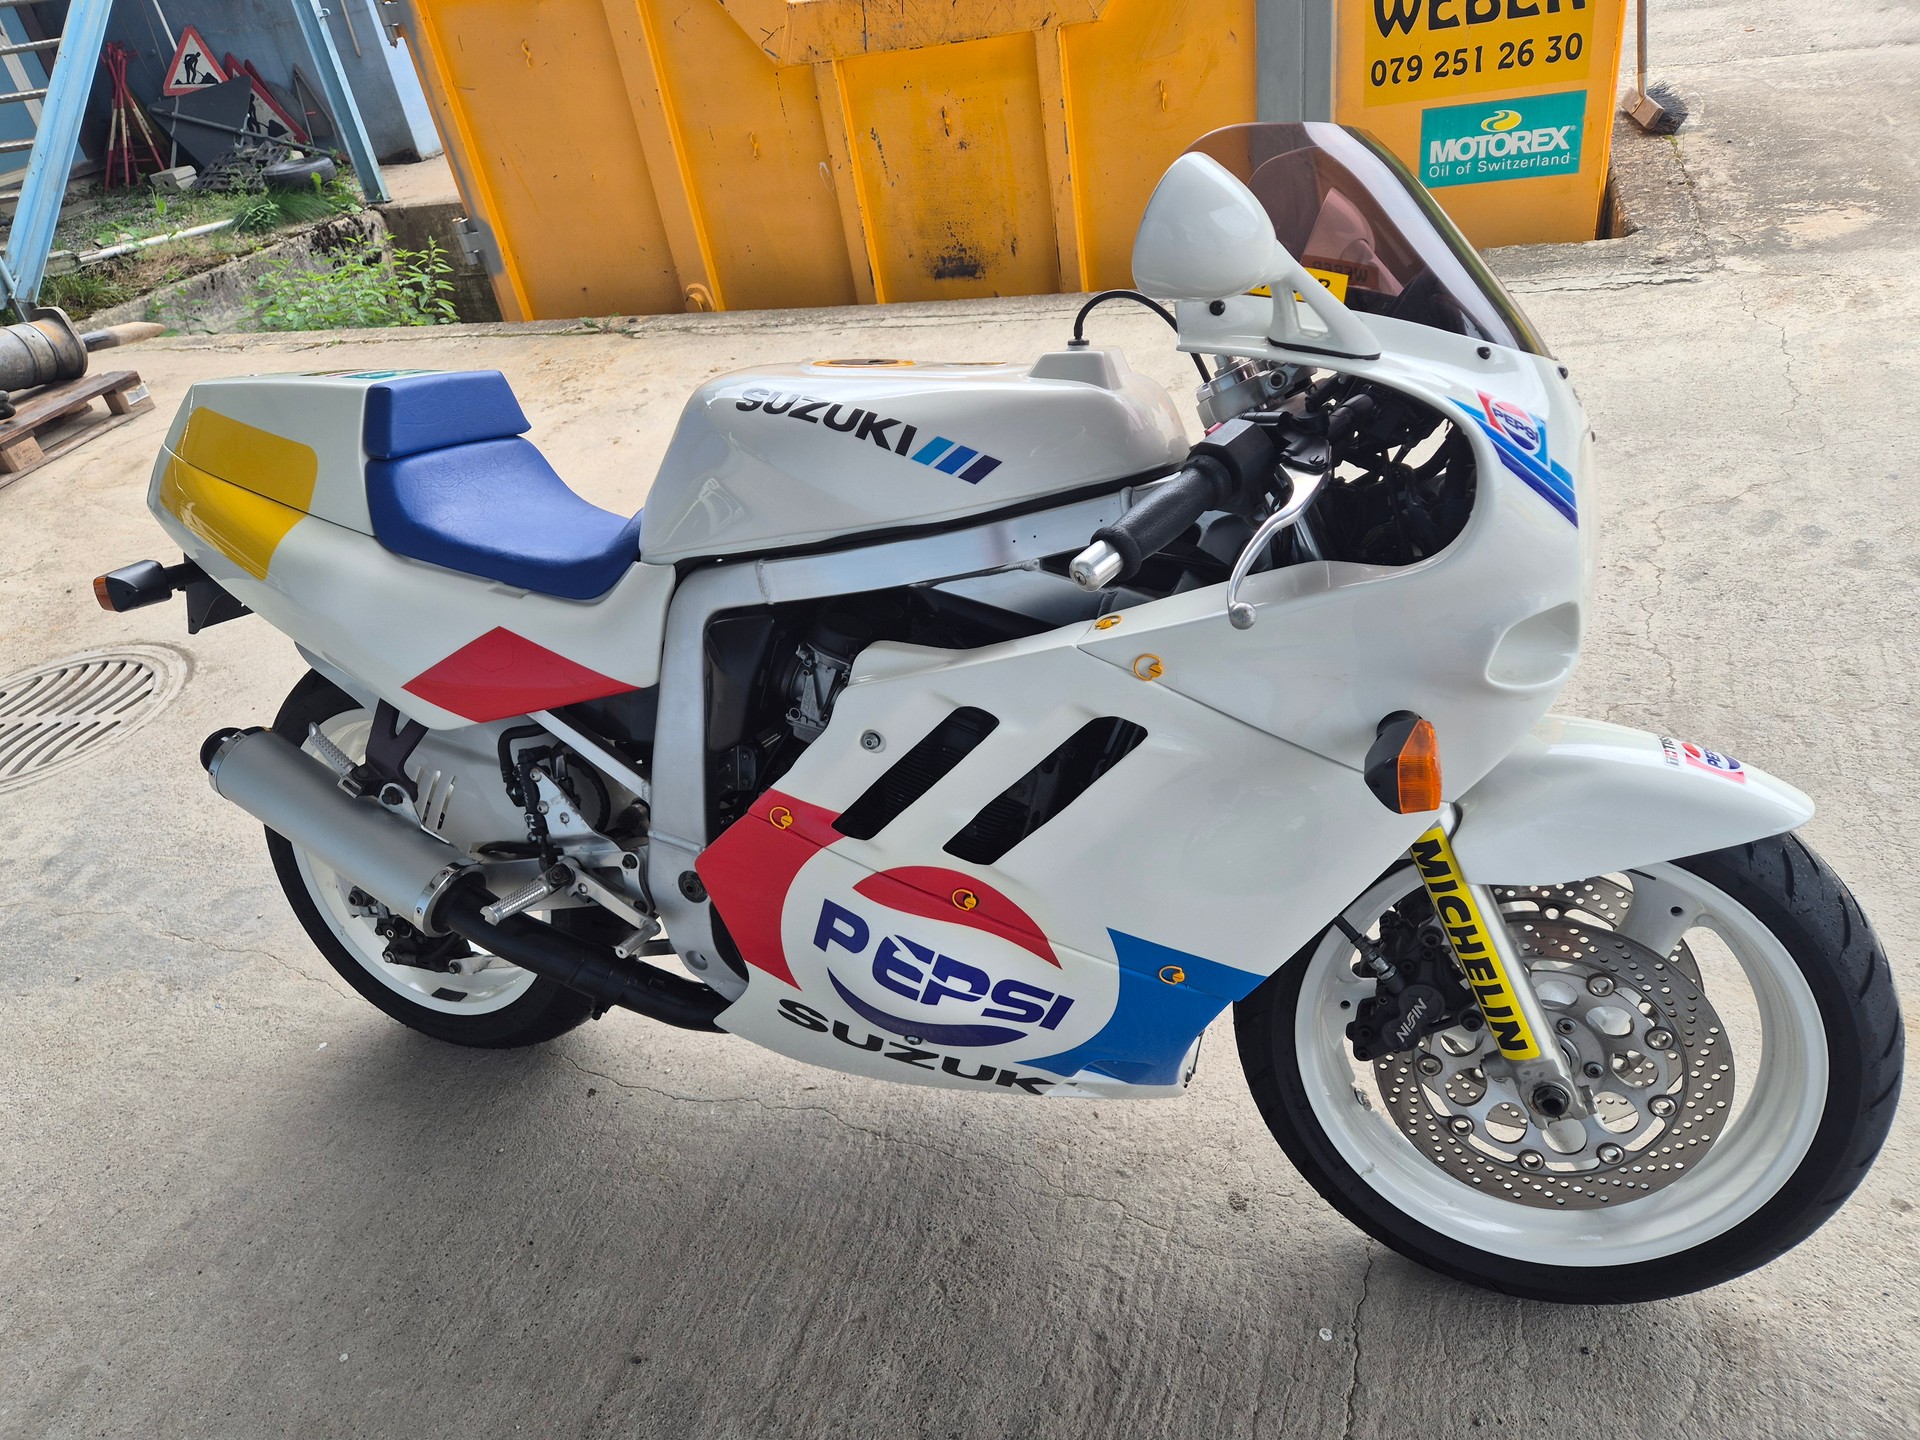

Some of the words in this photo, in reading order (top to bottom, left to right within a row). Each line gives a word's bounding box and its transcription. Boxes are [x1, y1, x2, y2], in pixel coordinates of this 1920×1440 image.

[1371, 55, 1423, 87] 079
[1433, 45, 1483, 79] 251
[1498, 39, 1534, 70] 26
[1545, 32, 1583, 63] 30
[1429, 165, 1450, 178] Oil
[1456, 161, 1472, 175] of
[1477, 151, 1571, 173] Switzerland
[735, 388, 918, 457] SUZUKI
[1492, 406, 1539, 443] PEPSI
[813, 898, 1075, 1031] PEPSI
[1411, 838, 1529, 1051] MICHELIN
[777, 998, 1078, 1096] SUZUK
